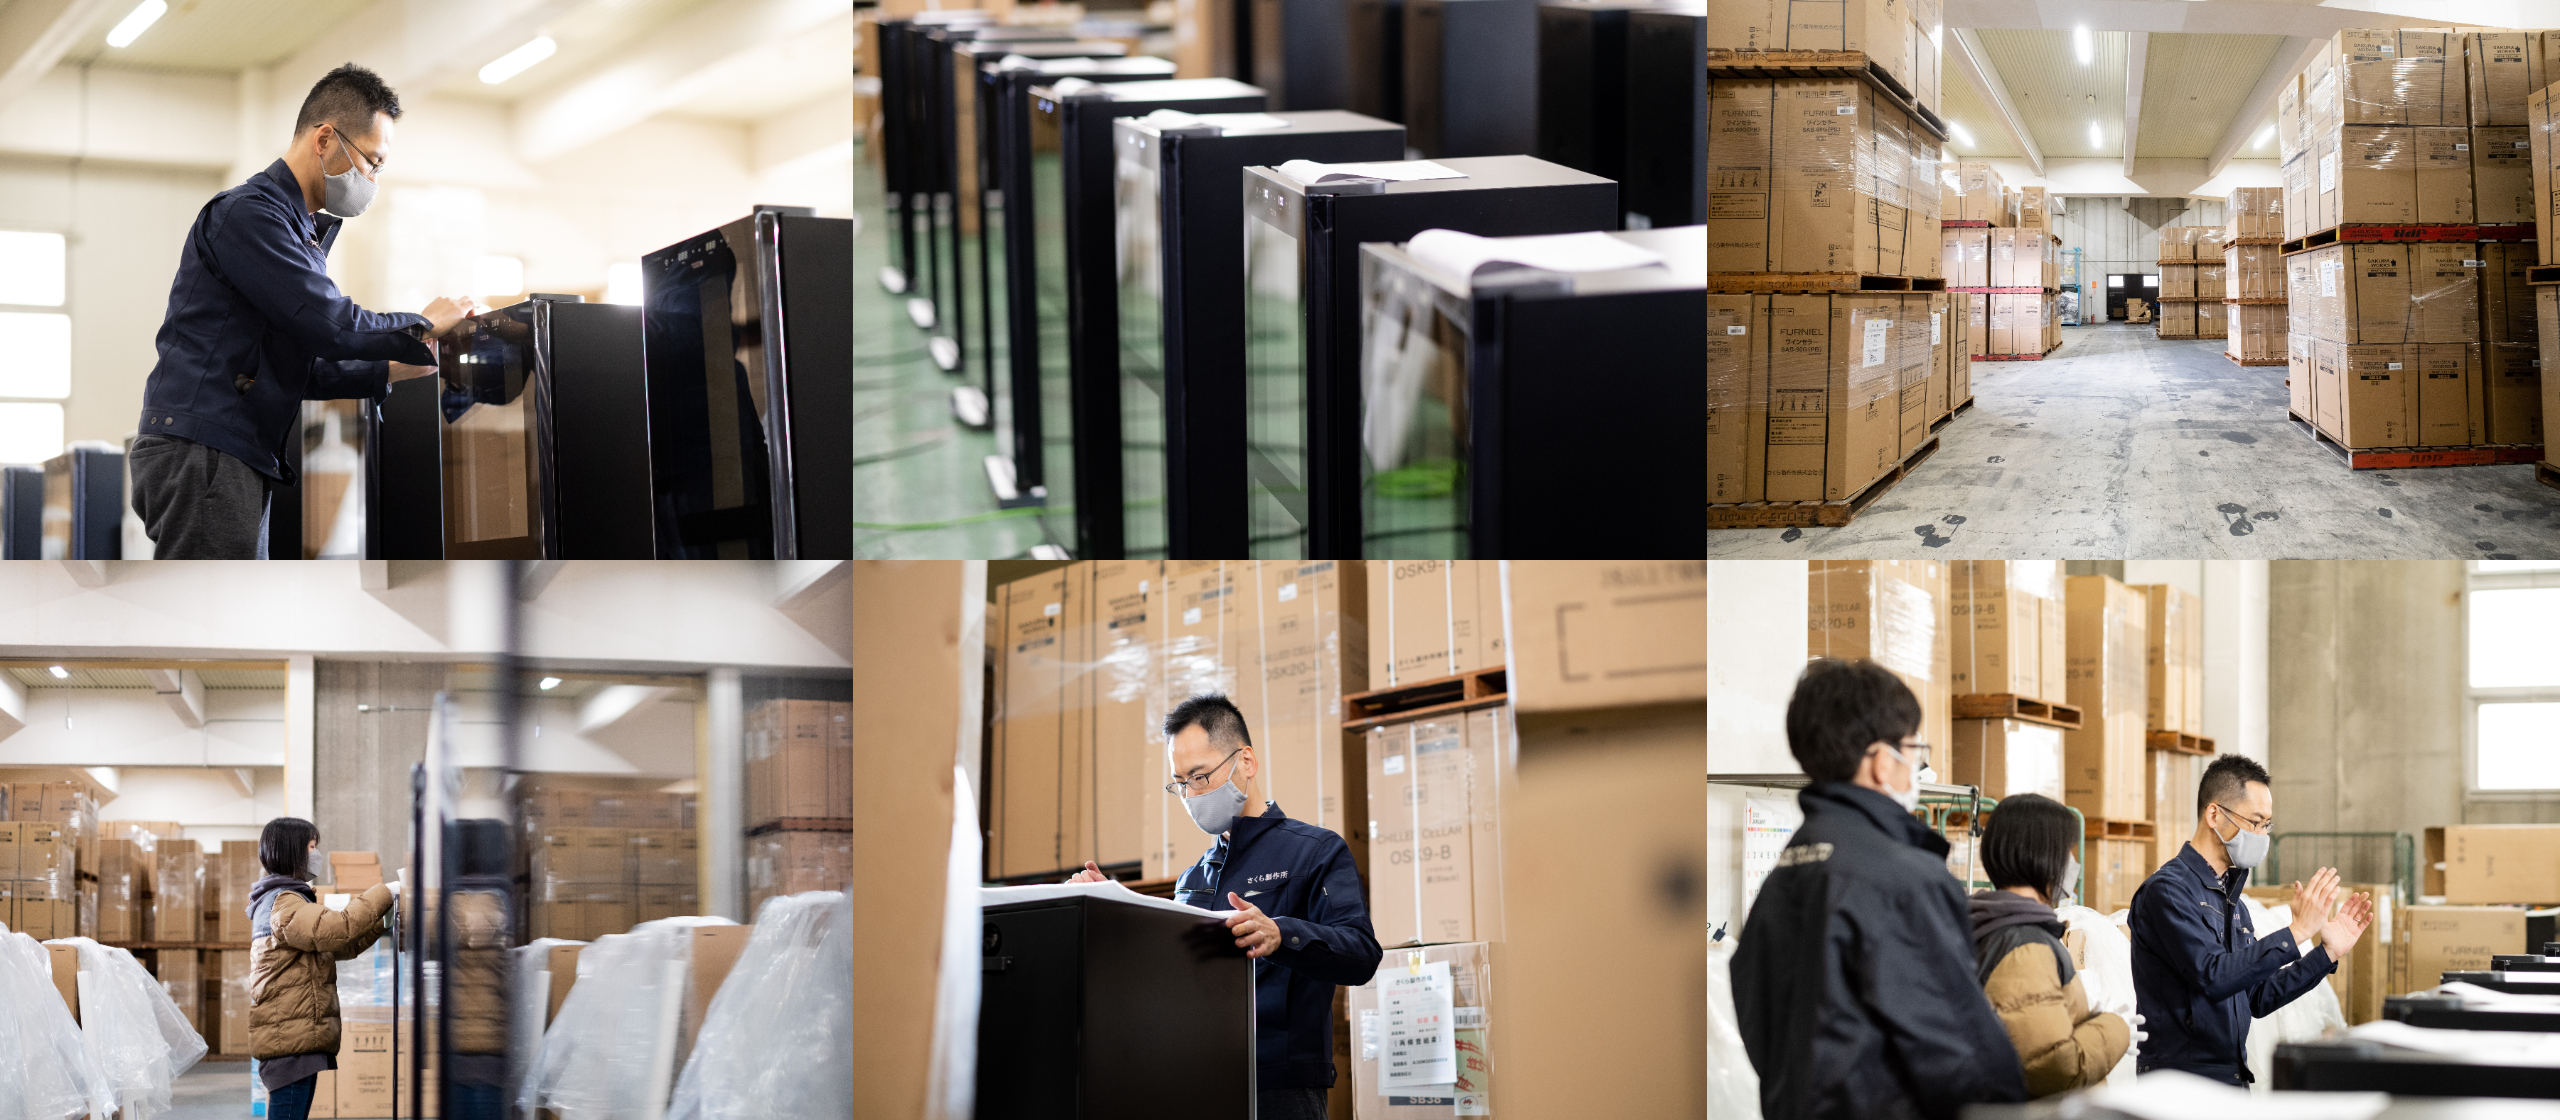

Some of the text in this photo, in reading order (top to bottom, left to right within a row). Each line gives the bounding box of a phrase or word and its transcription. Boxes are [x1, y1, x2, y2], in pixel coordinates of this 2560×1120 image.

[1780, 328, 1824, 336] FURNIEL
[1951, 603, 1996, 616] OS9-B
[1808, 616, 1856, 631] SK20-B
[1748, 806, 1752, 824] 1
[1421, 825, 1463, 840] CELLAR
[1389, 844, 1452, 866] OS9-B
[1247, 870, 1289, 884] さくら製作所
